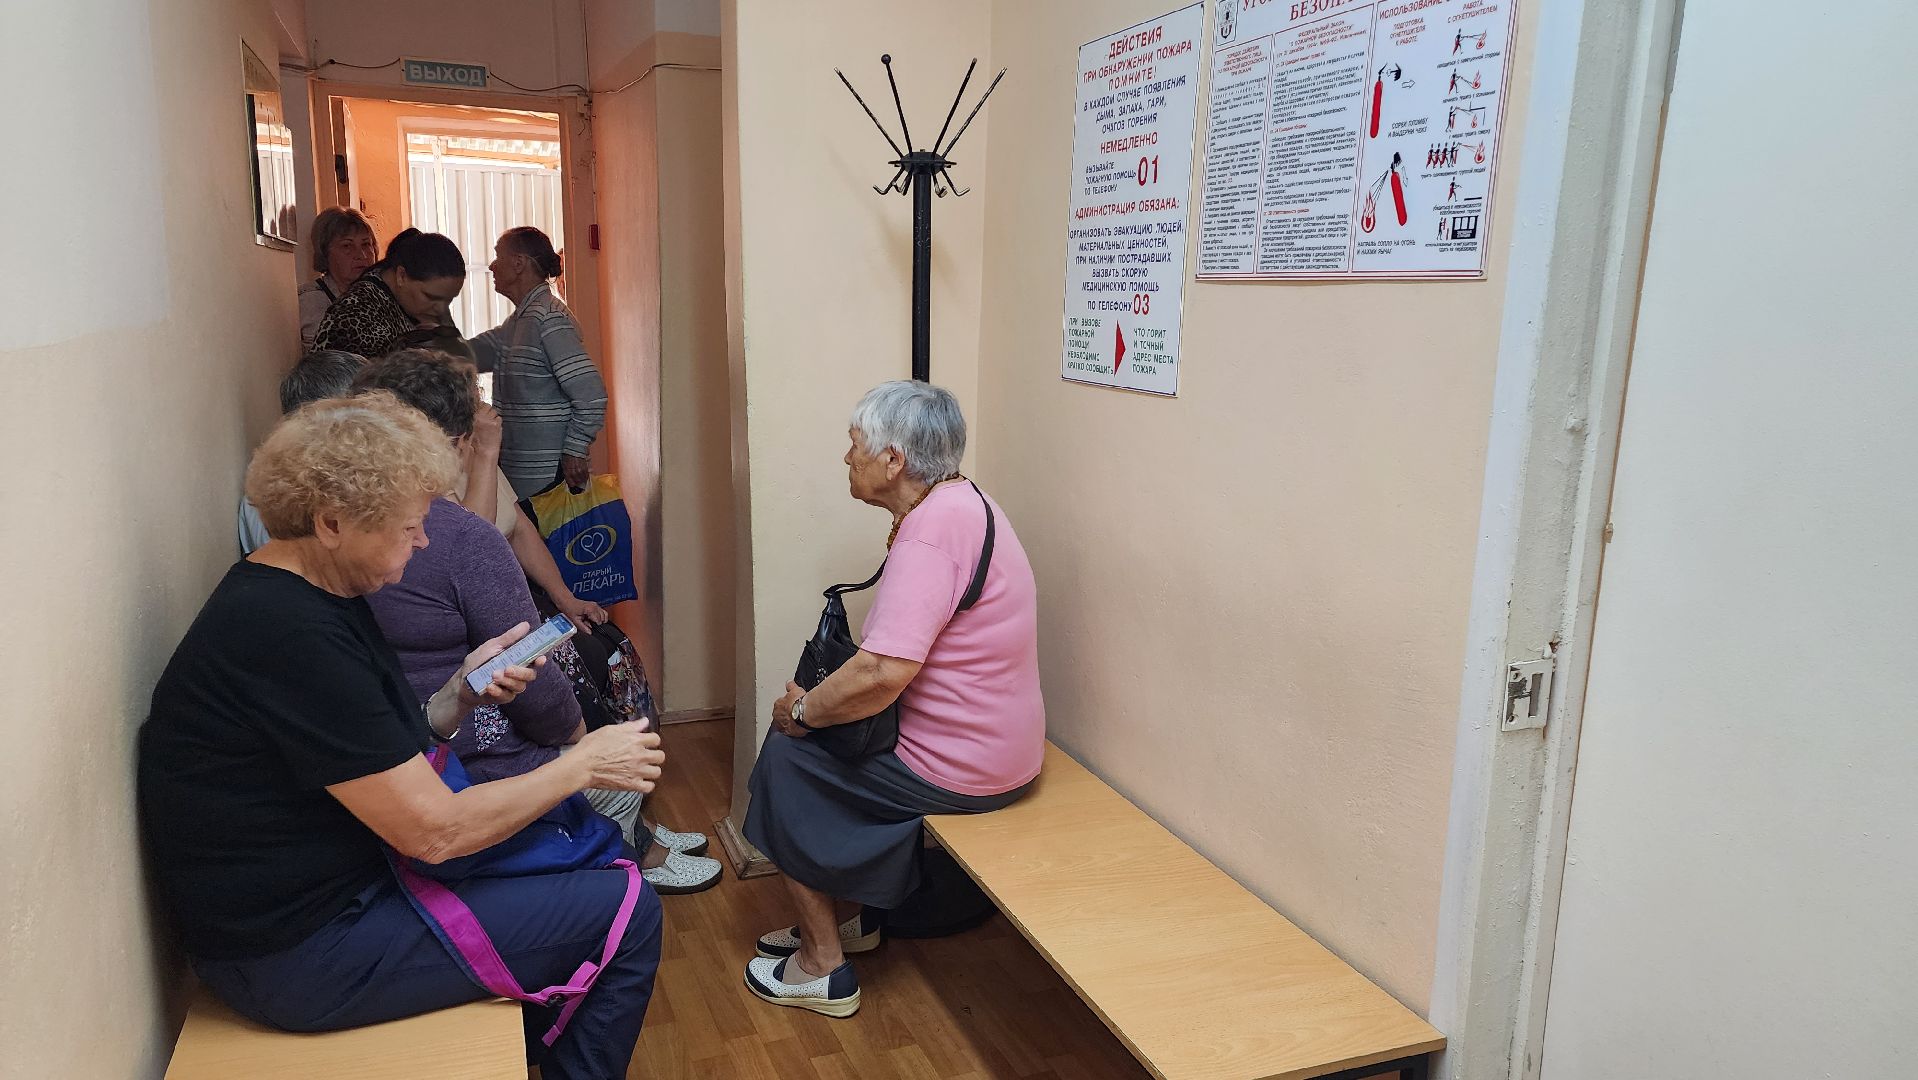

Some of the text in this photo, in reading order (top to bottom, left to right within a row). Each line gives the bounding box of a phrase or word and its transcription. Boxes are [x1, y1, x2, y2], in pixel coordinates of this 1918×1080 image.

[1452, 5, 1498, 23] ОГНЕТУШИТЕЛЕМ
[1108, 25, 1162, 61] ДЕЙСТВИЯ
[1083, 39, 1192, 84] ПРИ ОБНАРУЖЕНИИ ПОЖАРА
[409, 64, 483, 86] ВЫХОД
[1083, 75, 1186, 112] В КАЖДОМ СЛУЧАЕ ПОЯВЛЕНИЯ
[1096, 96, 1167, 123] ДЫМА, ЗАПАХА, ГАРИ,
[1102, 112, 1158, 134] ОЧАГОВ ГОРЕНИЯ
[1100, 131, 1158, 155] НЕМЕДЛЕННО
[1085, 161, 1115, 174] ВЫЗЫВАЙТЕ
[1137, 154, 1159, 187] 01
[1085, 170, 1137, 186] ПОЖАРНУЮ ПОМОЩЬ
[1085, 183, 1118, 196] ПО ТЕЛЕФОНУ
[1075, 197, 1180, 220] АДМИНИСТРАЦИЯ ОБЯЗАНА:
[1069, 220, 1184, 240] ОРГАНИЗОВАТЬ ЭВАКУАЦИЮ ЛЮДЕЙ,
[1078, 236, 1169, 252] МАТЕРИАЛЬНЫХ ЦЕННОСТЕЙ,
[1075, 252, 1172, 265] ПРИ НАЛИЧИИ ПОСТРАДАВШИХ
[1092, 268, 1149, 278] ВЫЗВАТЬ СКОРУЮ
[1082, 281, 1160, 293] МЕДИЦИНСКУЮ ПОМОЩЬ
[1087, 300, 1133, 312] ПО ТЕЛЕФОНУ
[1133, 293, 1150, 316] 03
[1081, 318, 1102, 328] ВЫЗОВЕ
[1133, 328, 1167, 338] ЧТО ГОРИТ
[1133, 340, 1164, 351] И ТОЧНЫЙ
[1067, 351, 1100, 362] НЕОБХОДИМО
[1133, 352, 1174, 364] АДРЕС МЕСТА
[1067, 362, 1114, 375] КРАТКО СООБЩИТЬ
[1132, 364, 1157, 375] ПОЖАРА
[582, 566, 612, 579] СТАРЫЙ
